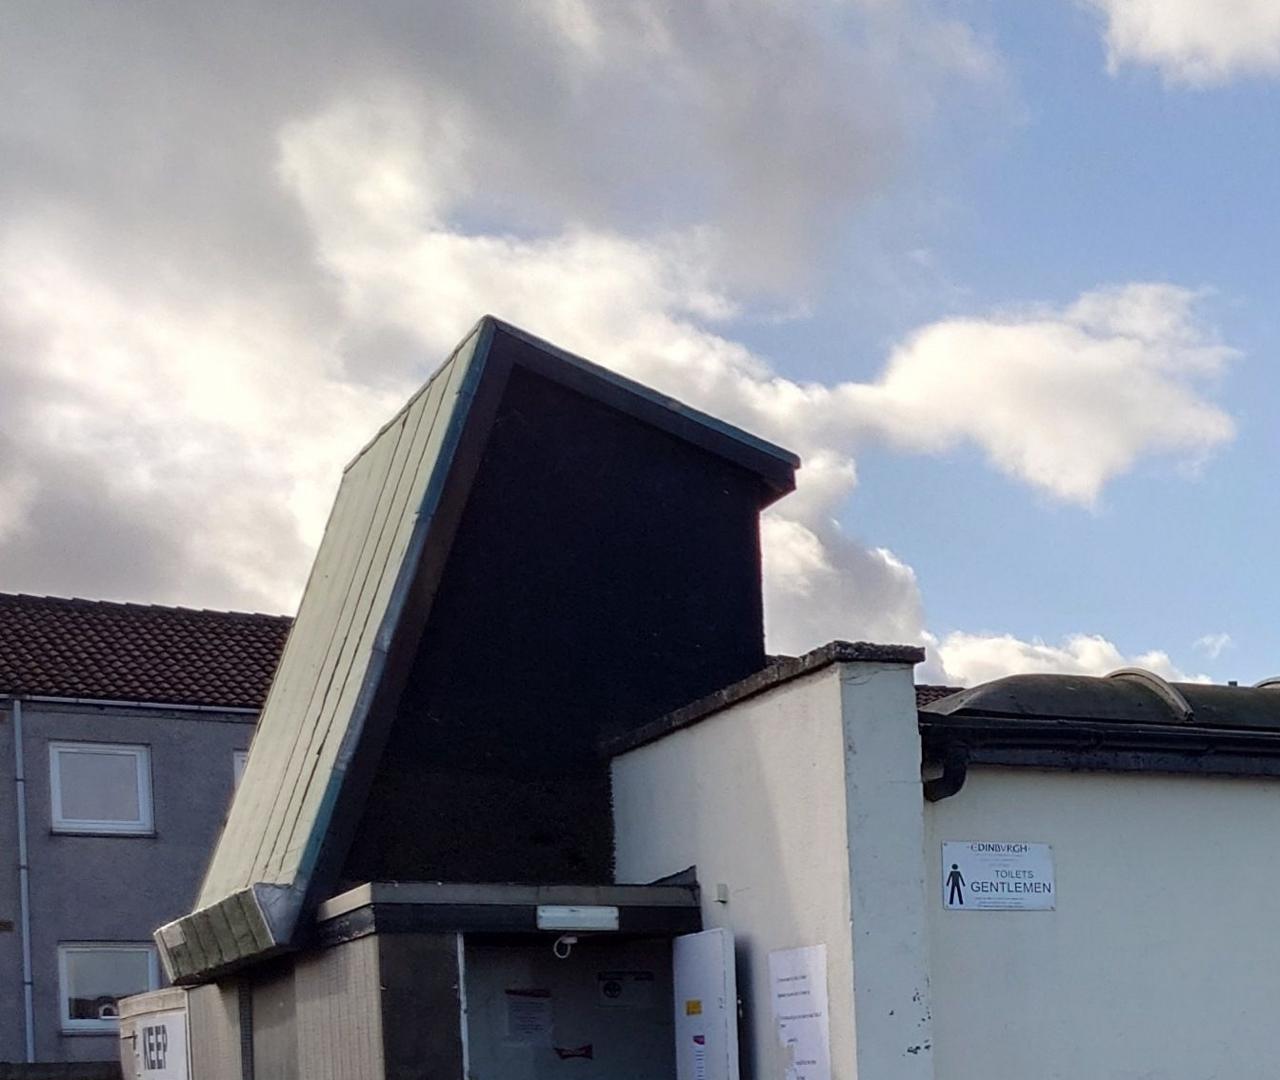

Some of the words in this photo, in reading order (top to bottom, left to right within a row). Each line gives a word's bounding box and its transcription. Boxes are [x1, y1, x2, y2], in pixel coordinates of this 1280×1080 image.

[994, 869, 1035, 879] TOILETS
[970, 881, 1052, 893] GENTLEMEN
[142, 1024, 168, 1070] KEEP
